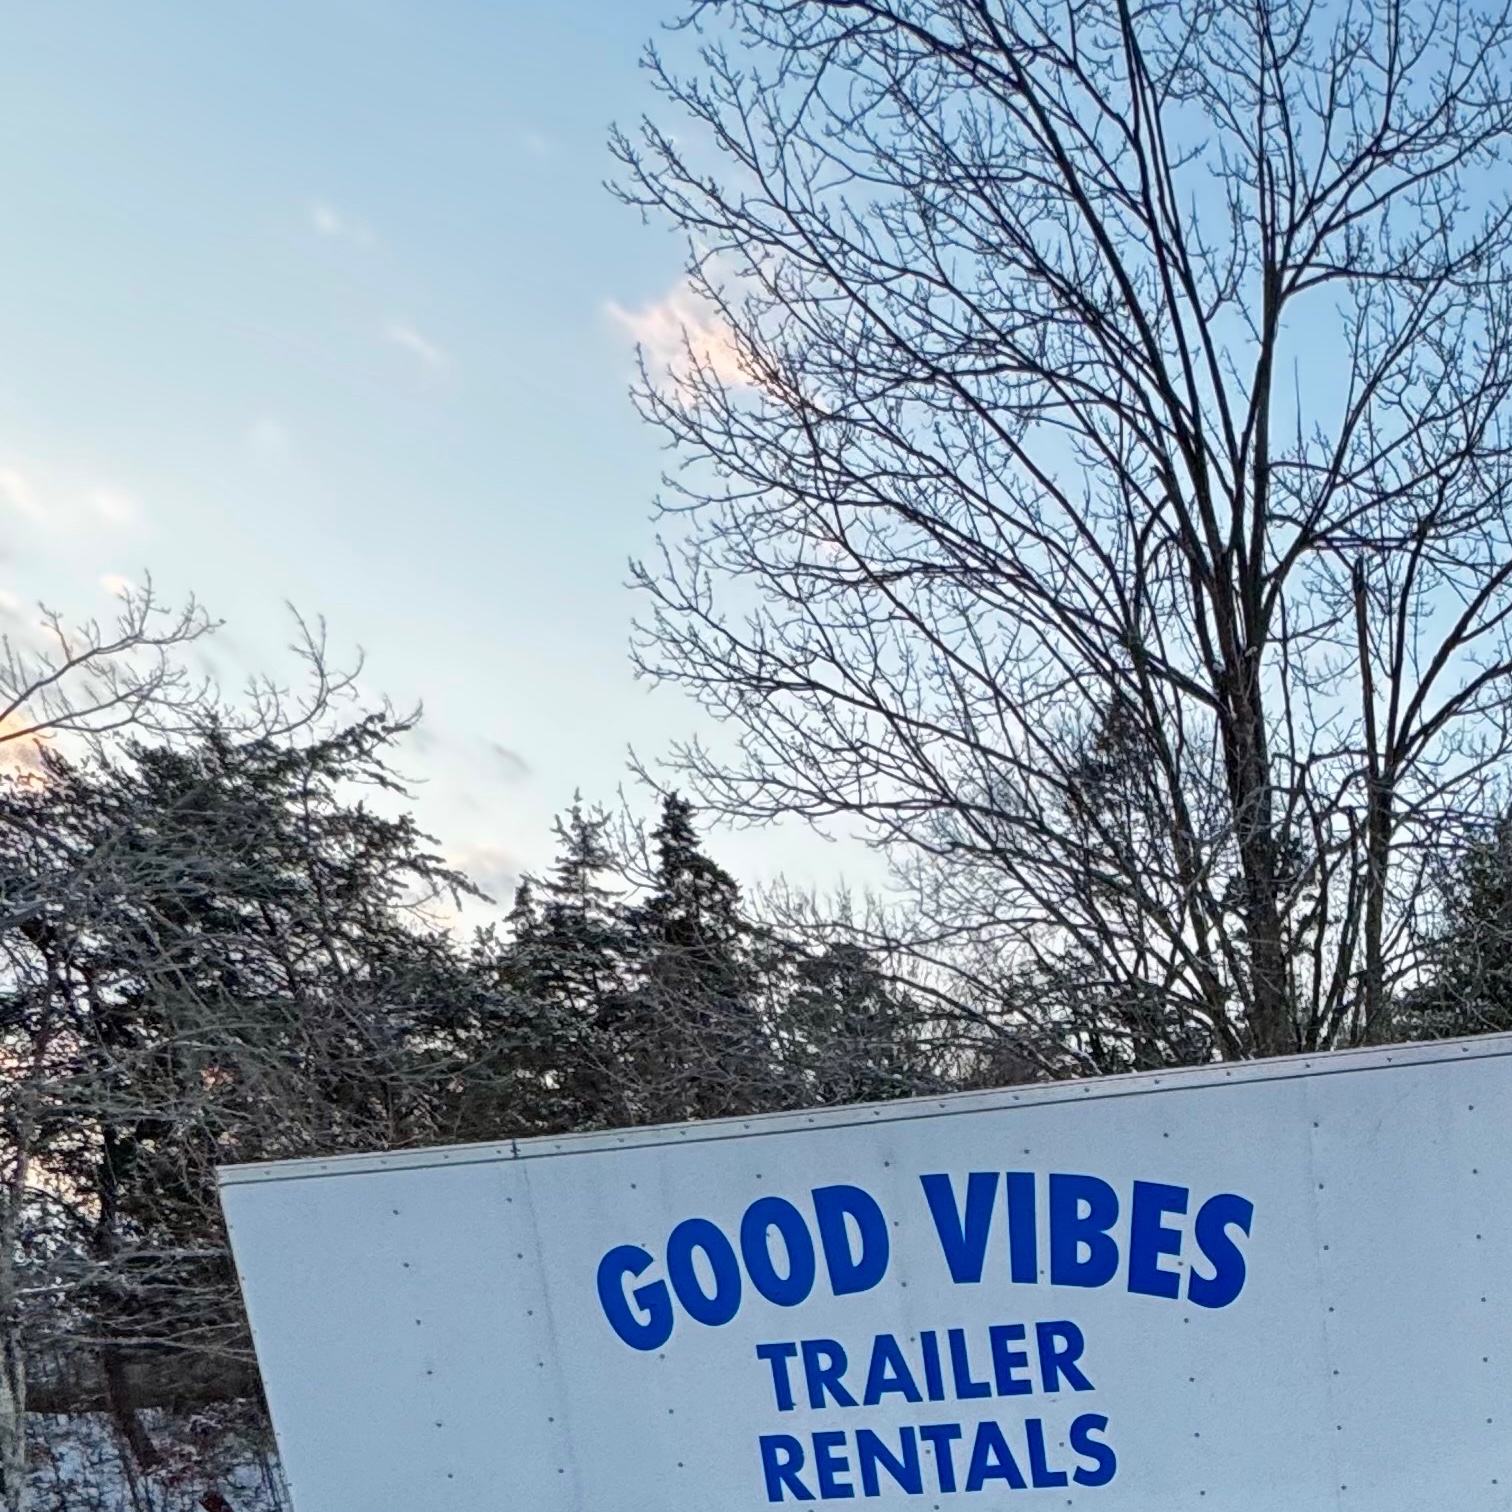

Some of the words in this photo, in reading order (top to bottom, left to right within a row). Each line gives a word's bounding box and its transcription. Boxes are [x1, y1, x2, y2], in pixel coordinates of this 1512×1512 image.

[596, 1184, 890, 1352] GOOD
[918, 1171, 1255, 1310] VIBES
[755, 1319, 1096, 1412] TRAILER
[758, 1412, 1118, 1503] RENTALS
